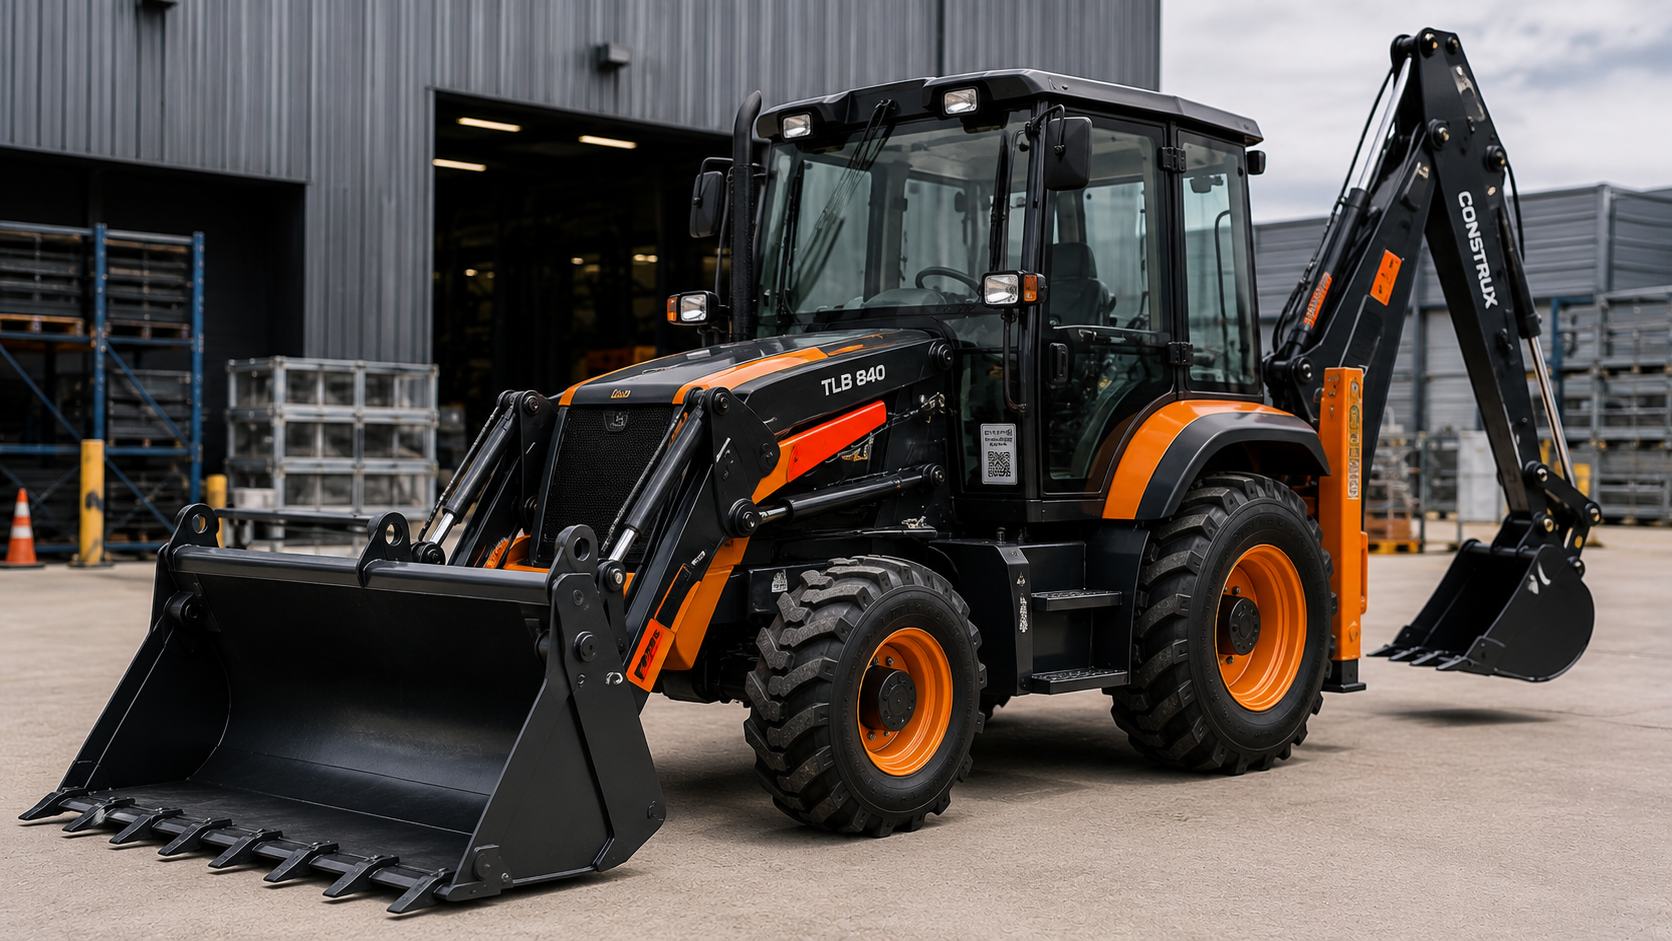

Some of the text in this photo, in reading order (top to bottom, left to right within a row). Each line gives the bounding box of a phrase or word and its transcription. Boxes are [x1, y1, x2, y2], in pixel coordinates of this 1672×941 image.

[1458, 191, 1498, 309] CONSTRUX
[821, 364, 885, 396] TLB 840
